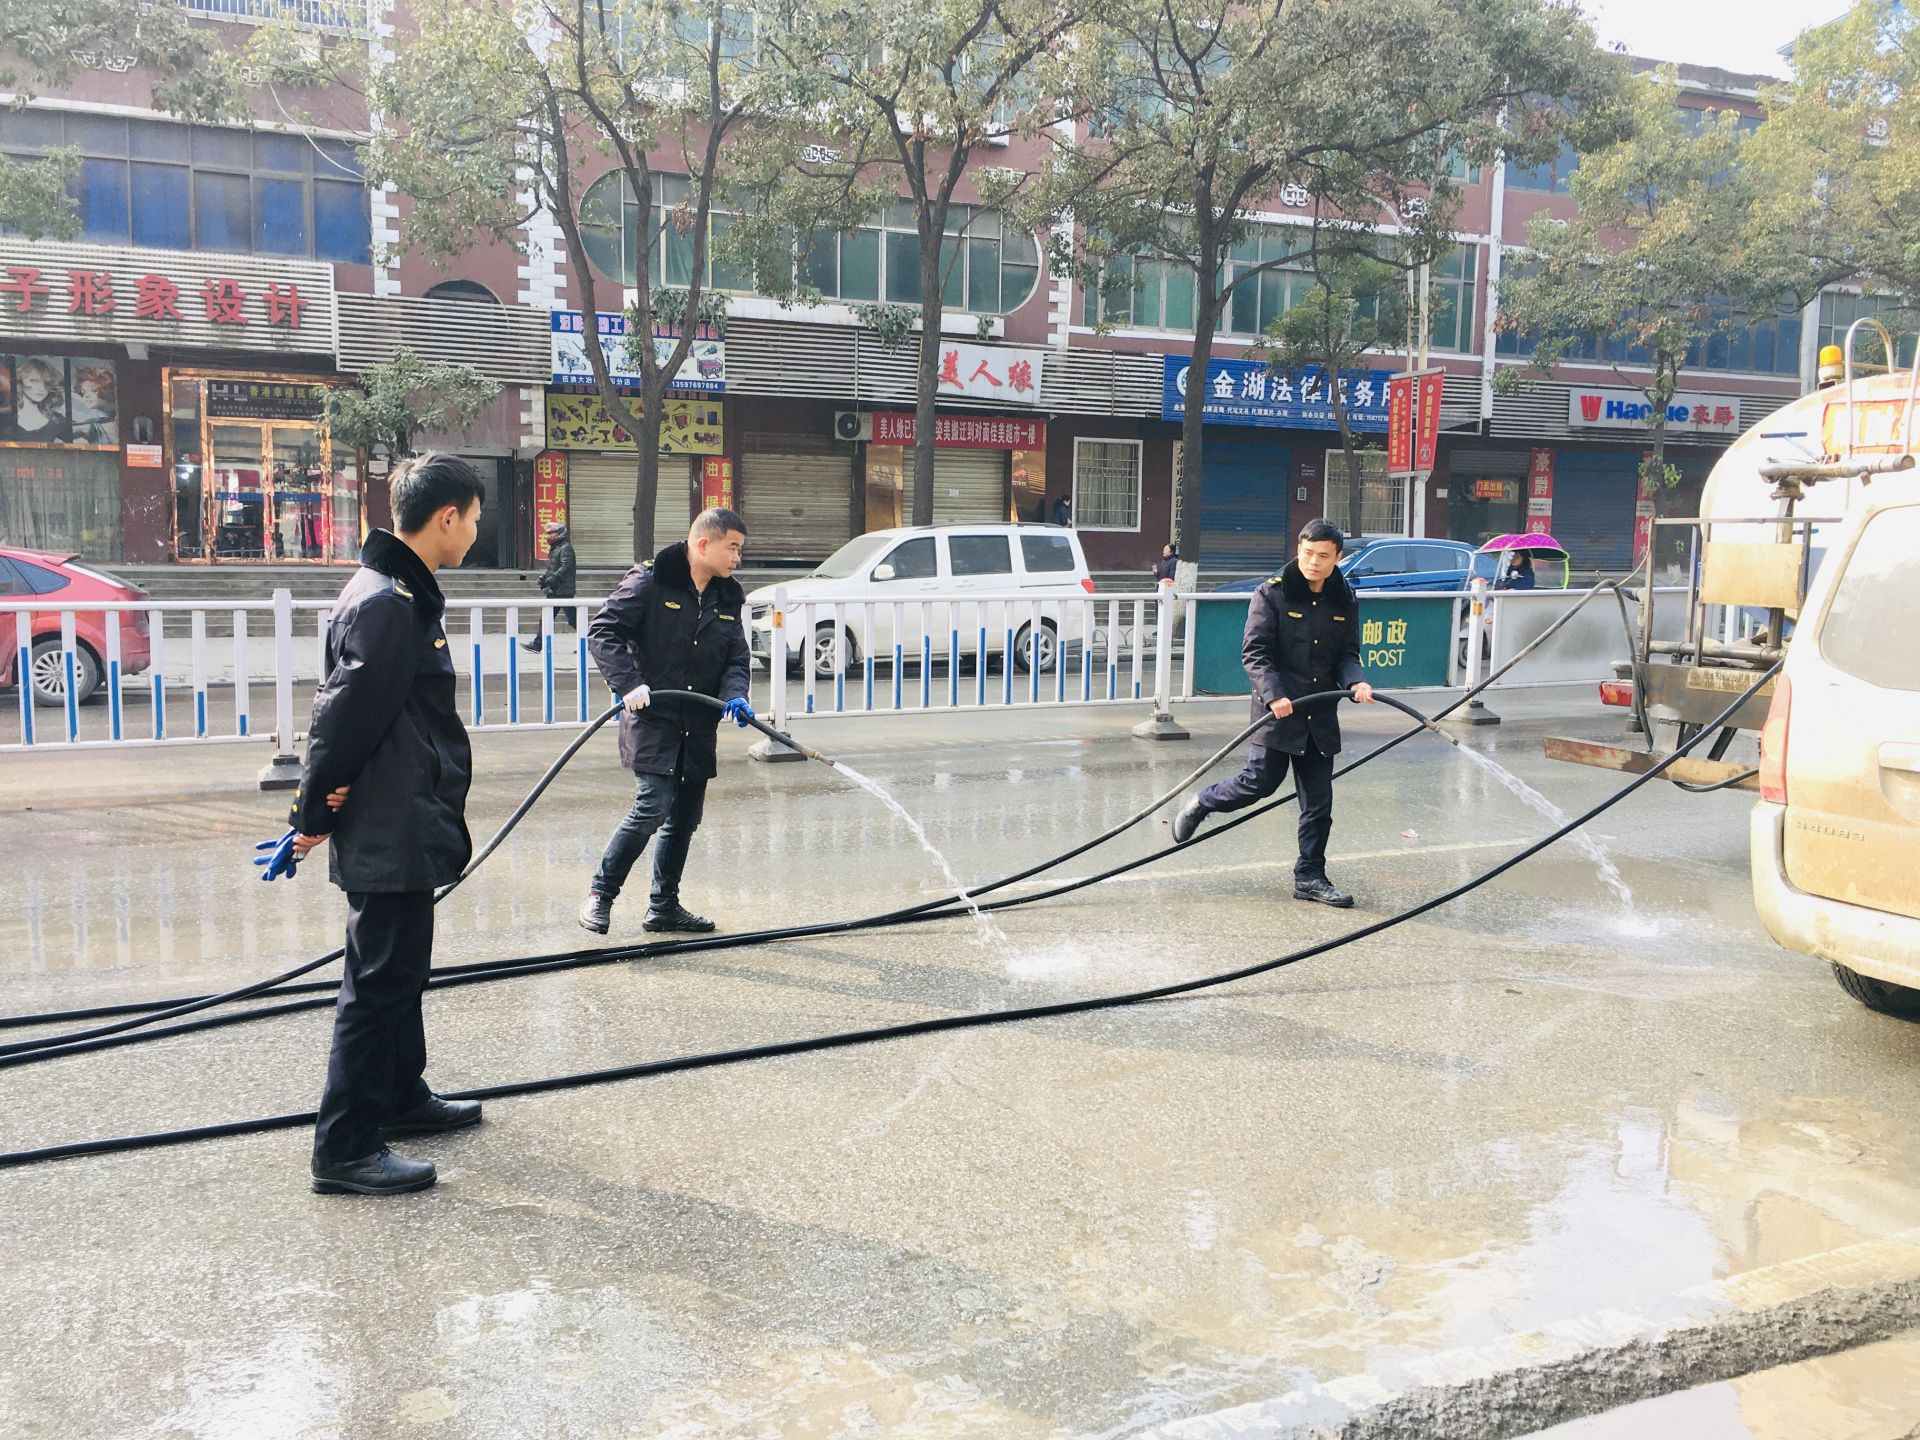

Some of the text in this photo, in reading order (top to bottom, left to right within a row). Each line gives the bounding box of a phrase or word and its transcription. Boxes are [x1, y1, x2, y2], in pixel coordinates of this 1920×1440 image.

[0, 266, 308, 328] 子形象设计
[937, 350, 1034, 393] 美人缘
[1606, 400, 1689, 422] Haoue
[880, 417, 1036, 445] 美人缘已更姿美搬迁到对面佳美超市一楼
[1362, 618, 1408, 645] 邮政
[1368, 648, 1406, 668] POST
